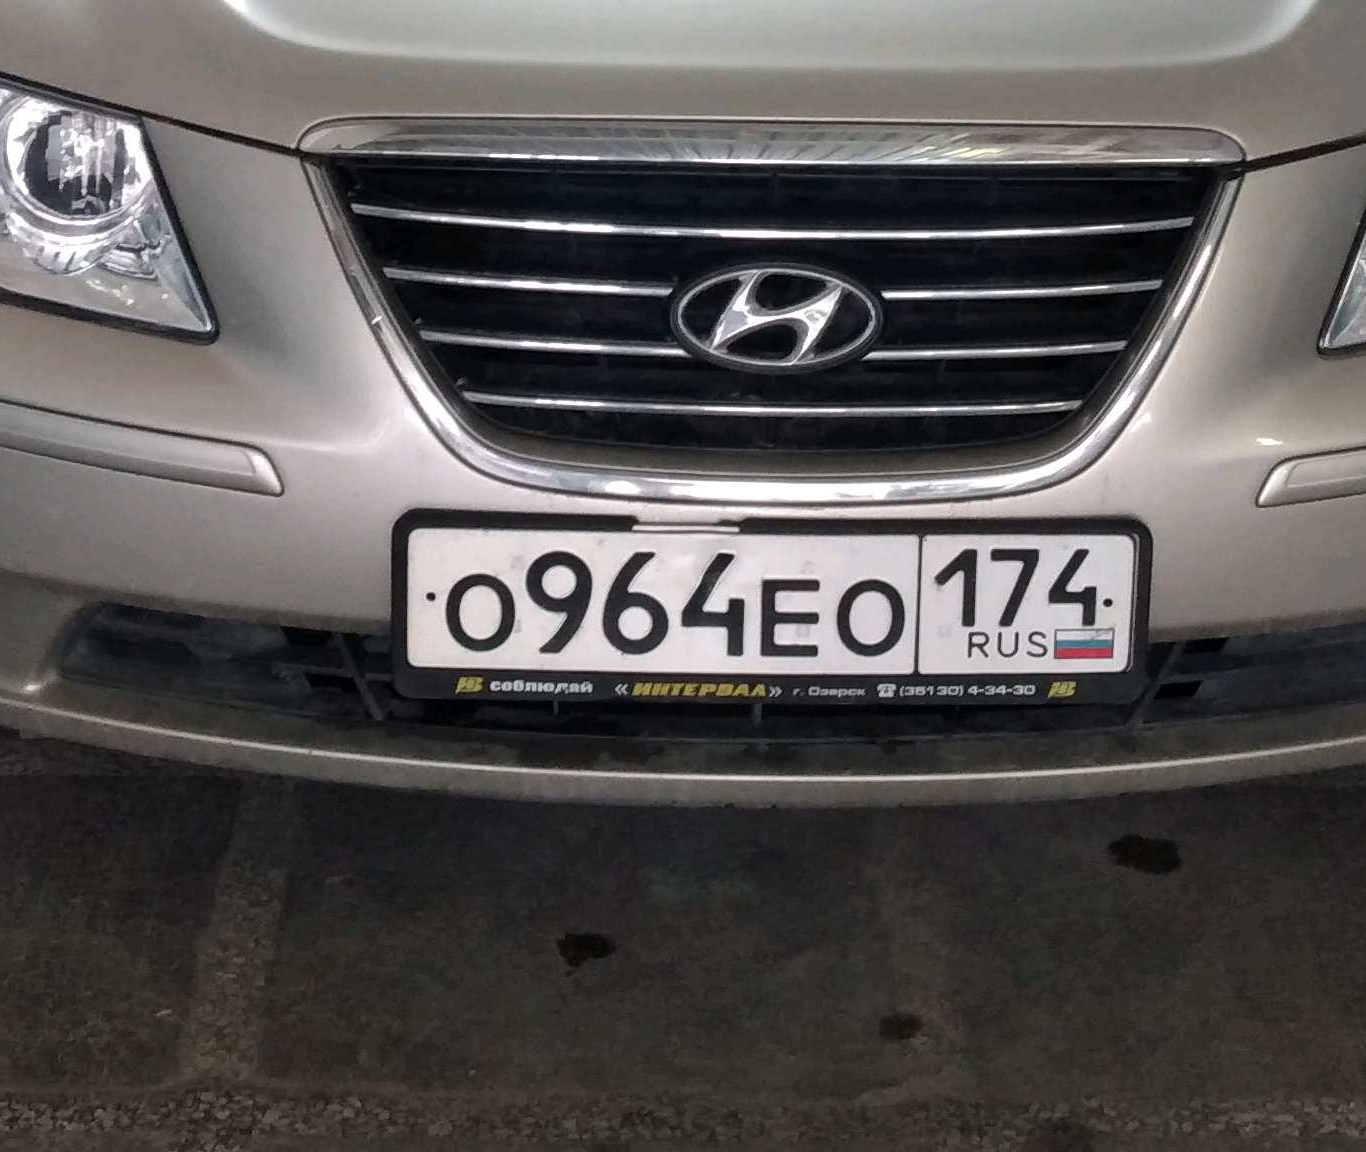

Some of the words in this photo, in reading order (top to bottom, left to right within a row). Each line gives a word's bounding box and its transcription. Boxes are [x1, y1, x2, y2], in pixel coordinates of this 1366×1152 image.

[934, 548, 1097, 626] 174
[967, 631, 1049, 659] RUS
[967, 684, 1036, 696] 4-34-30
